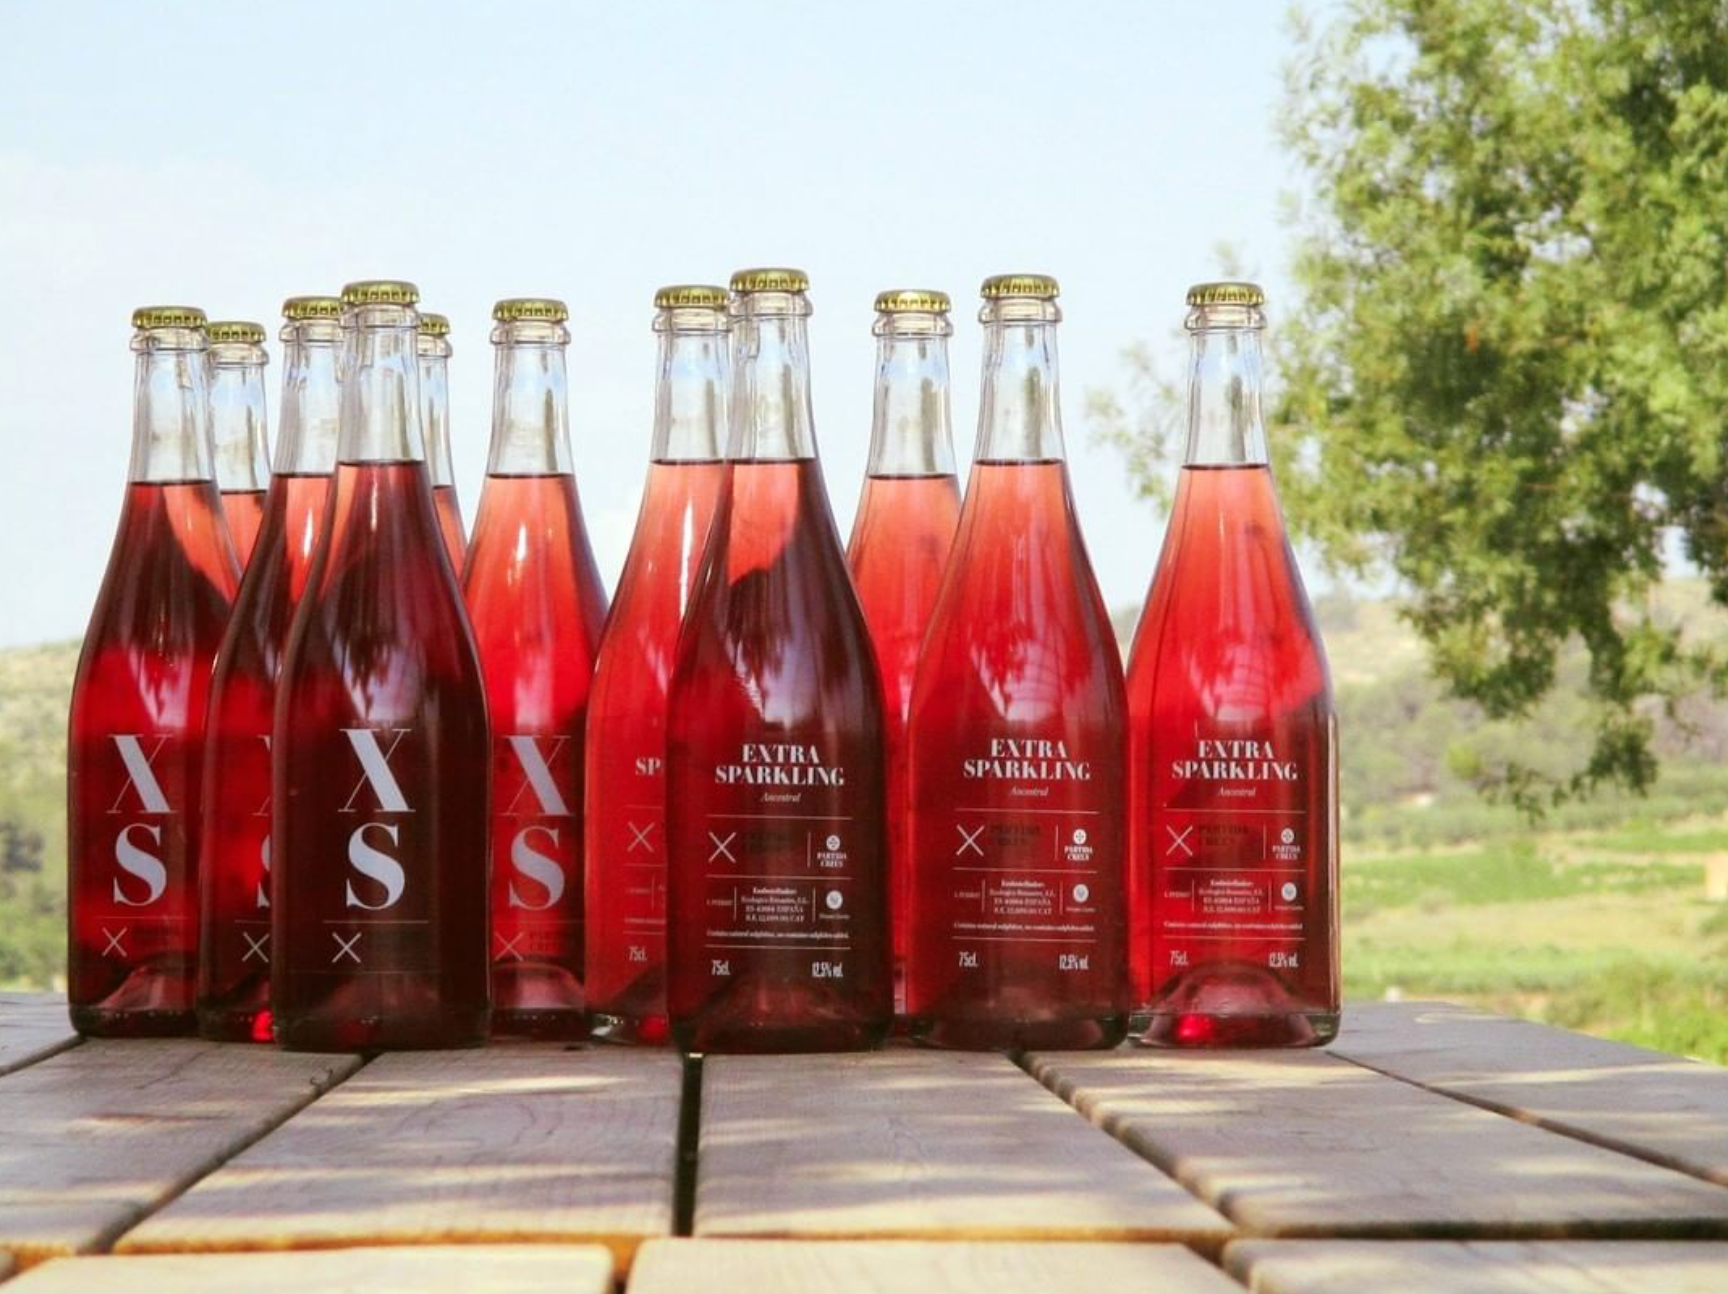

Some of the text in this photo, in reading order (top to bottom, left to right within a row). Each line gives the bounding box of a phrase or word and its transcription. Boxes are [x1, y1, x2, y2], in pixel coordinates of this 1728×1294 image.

[338, 729, 416, 813] X
[742, 744, 819, 764] EXTRA
[963, 760, 1091, 780] SPARKLING
[990, 738, 1068, 758] EXTRA
[1172, 760, 1298, 780] SPARKLING
[1198, 740, 1275, 759] EXTRA
[106, 734, 178, 814] X
[502, 735, 572, 816] X
[715, 766, 845, 786] SPARKLING
[113, 823, 167, 906] S
[346, 822, 405, 910] S
[508, 826, 566, 911] S
